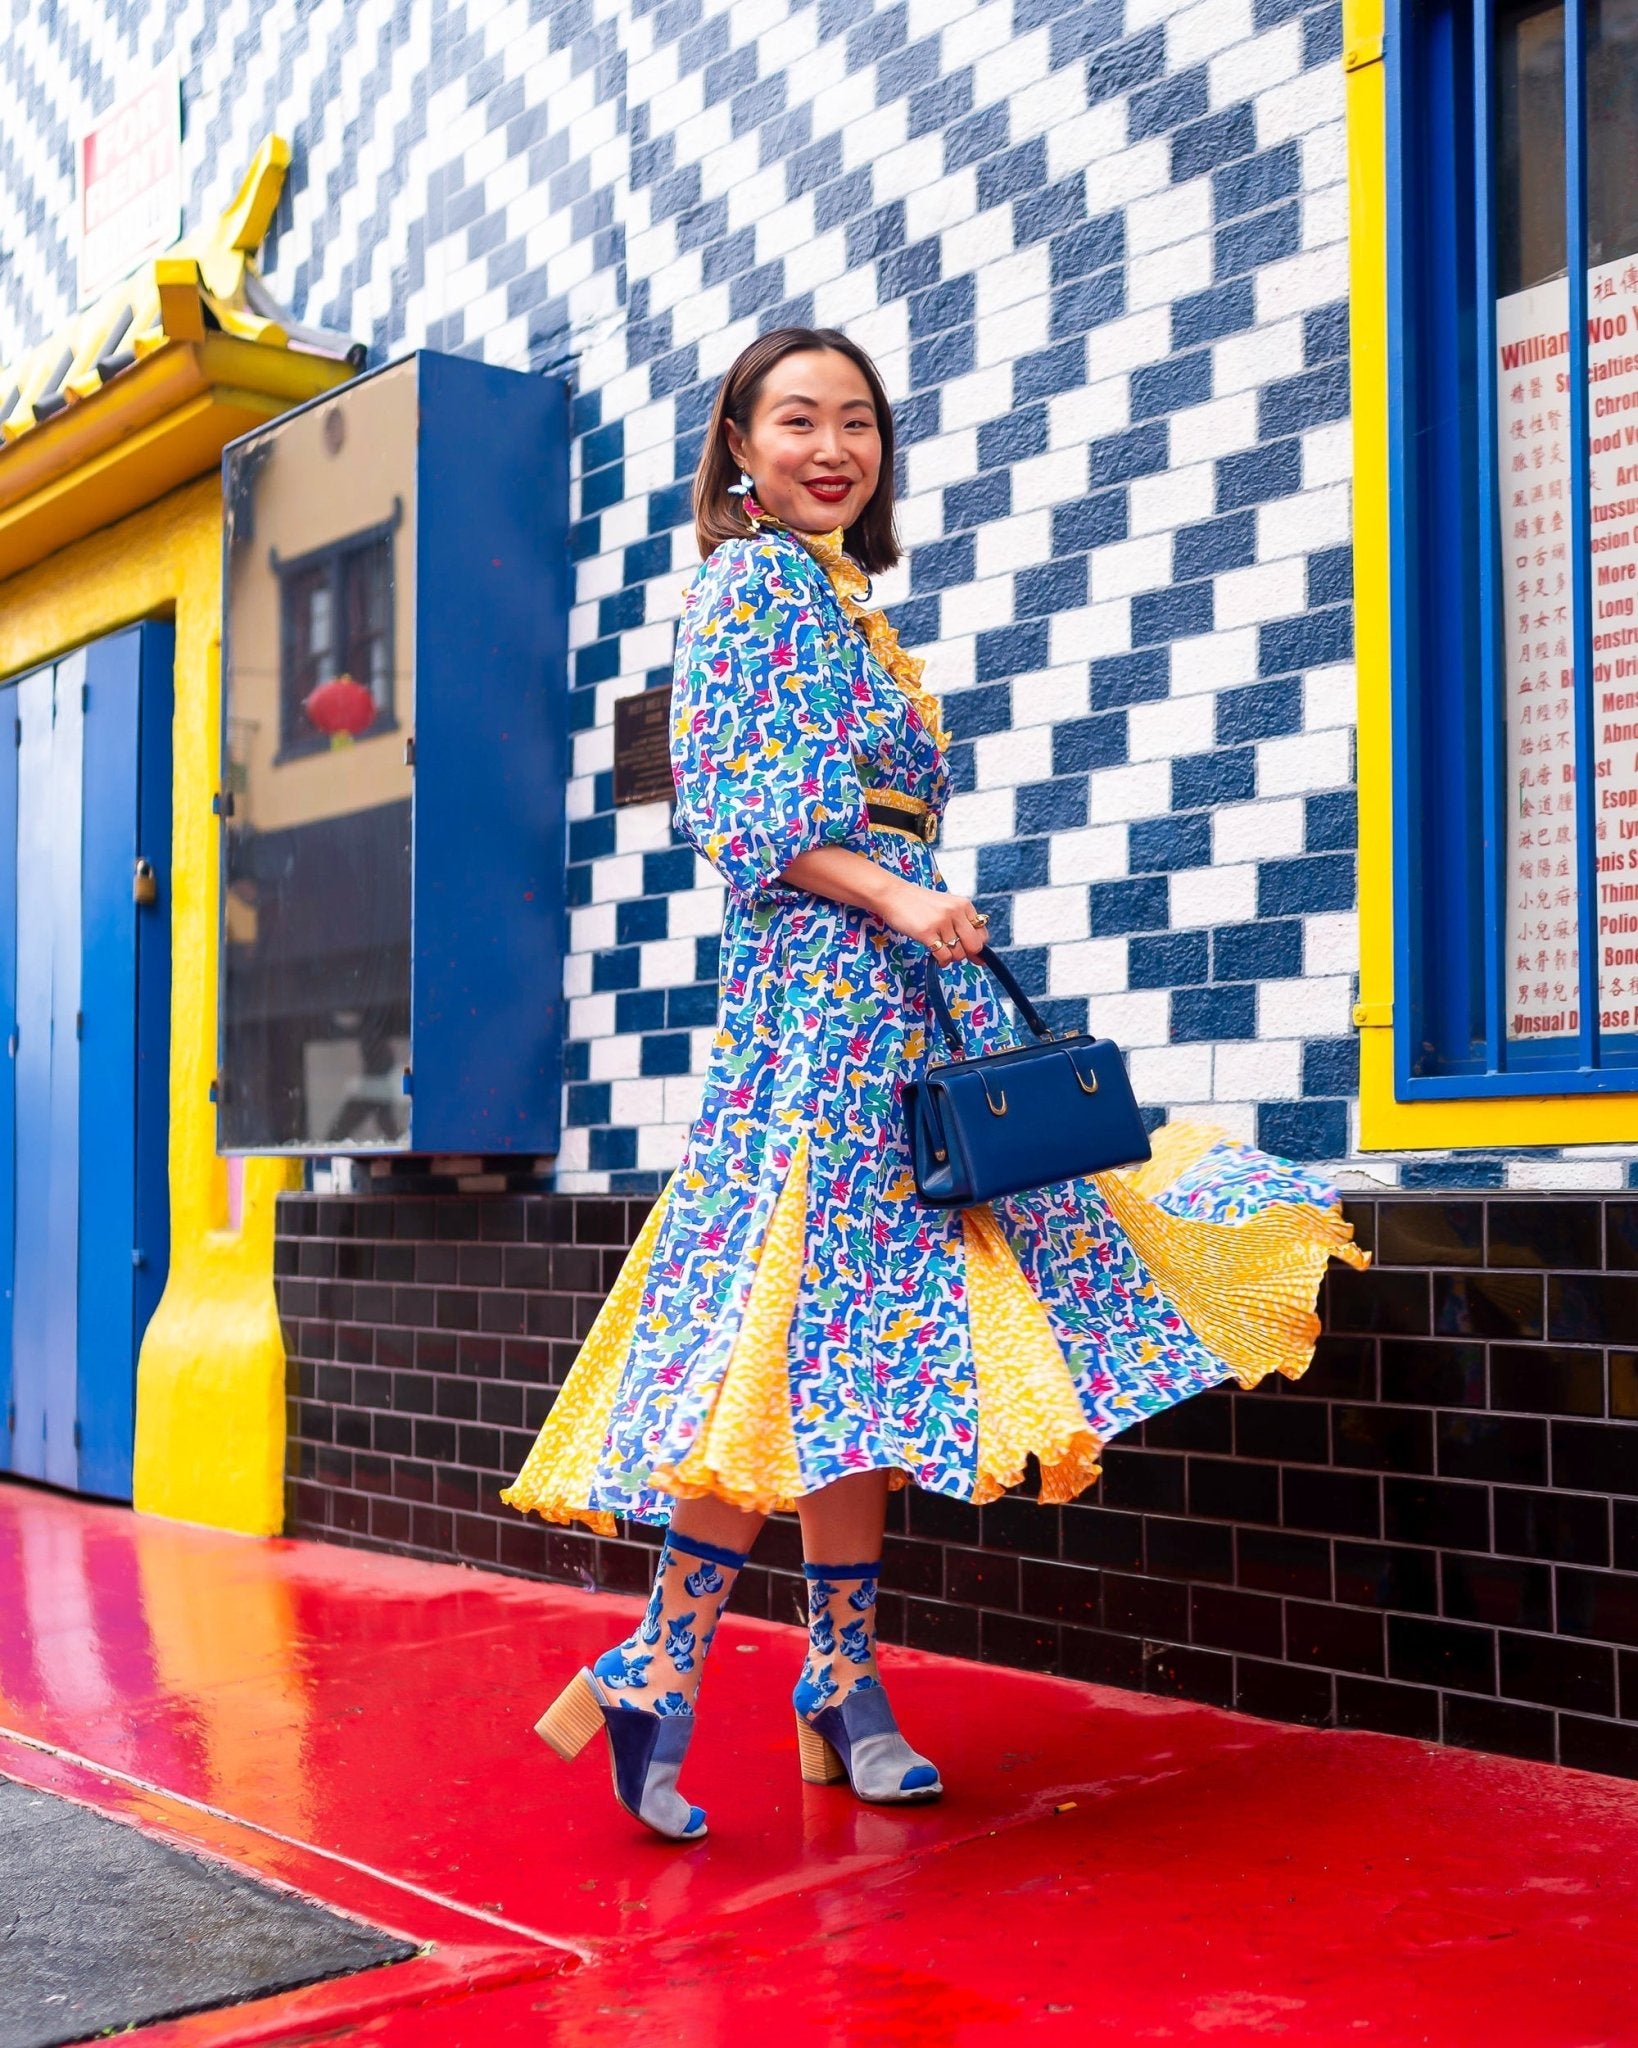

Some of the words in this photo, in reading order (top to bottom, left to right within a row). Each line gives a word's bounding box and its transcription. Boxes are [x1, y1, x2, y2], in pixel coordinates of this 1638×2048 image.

[98, 89, 160, 173] FOR
[86, 125, 171, 228] RENT
[1591, 531, 1629, 554] osion
[1598, 563, 1636, 586] More
[1599, 597, 1633, 619] Long
